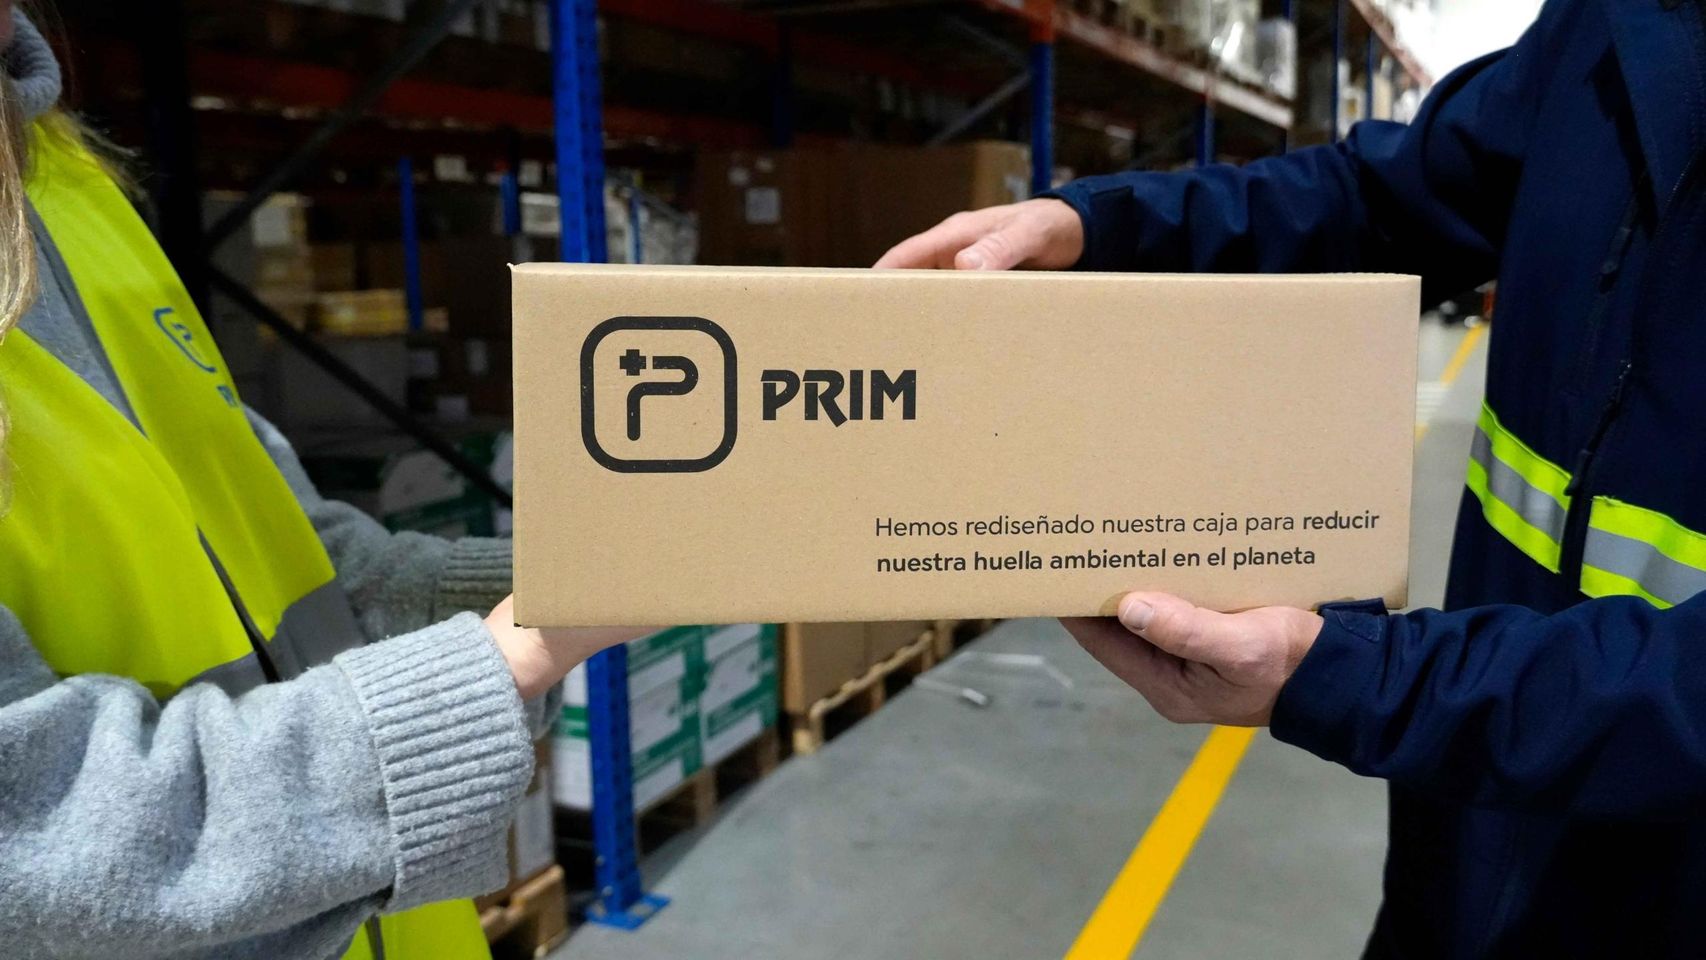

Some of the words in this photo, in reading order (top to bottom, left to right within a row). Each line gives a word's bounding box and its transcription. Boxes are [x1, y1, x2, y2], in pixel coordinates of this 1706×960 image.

[760, 369, 917, 428] PRIM
[875, 517, 958, 537] Hemos
[966, 513, 1095, 536] rediseñado
[1102, 514, 1186, 534] nuestra
[1192, 512, 1238, 537] caja
[1245, 516, 1294, 537] para
[1303, 510, 1380, 531] reducir
[877, 552, 966, 573] nuestra
[974, 550, 1043, 571] huella
[1049, 547, 1166, 570] ambiental
[1172, 552, 1200, 567] en
[1207, 546, 1226, 567] el
[1233, 546, 1315, 571] planeta
